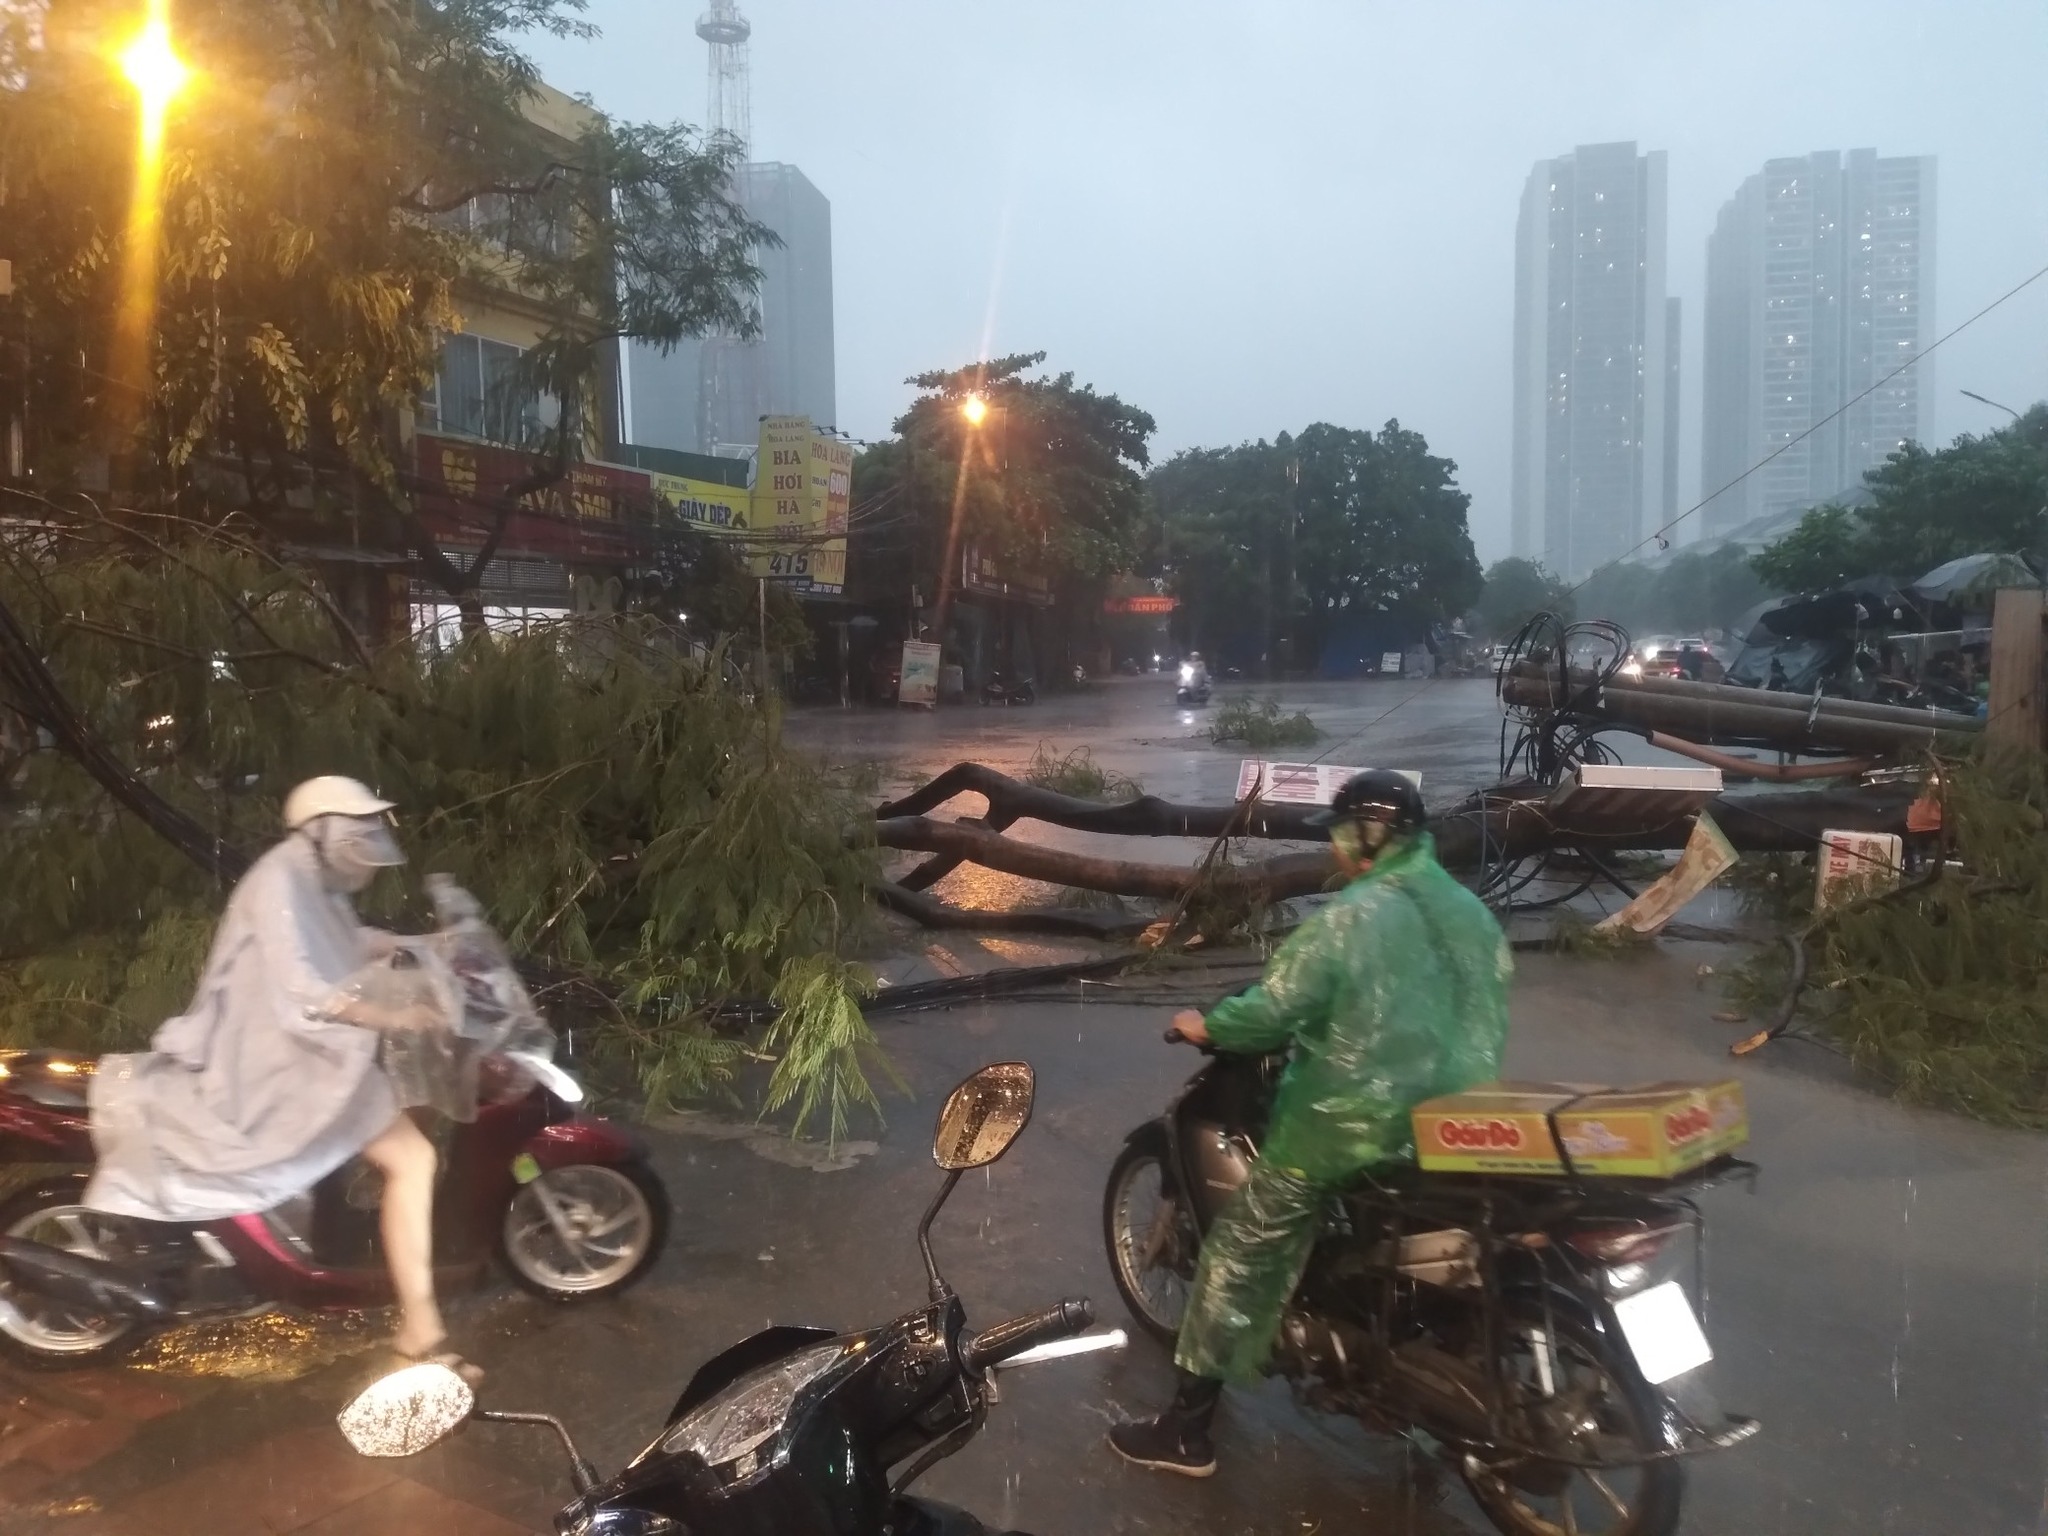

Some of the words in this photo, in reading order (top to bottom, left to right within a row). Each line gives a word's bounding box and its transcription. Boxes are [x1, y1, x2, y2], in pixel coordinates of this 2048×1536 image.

[773, 450, 802, 466] BIA
[773, 473, 803, 490] HƠI
[830, 471, 849, 496] 600
[777, 496, 801, 515] HÀ
[769, 550, 809, 575] 415
[1829, 860, 1849, 874] XE
